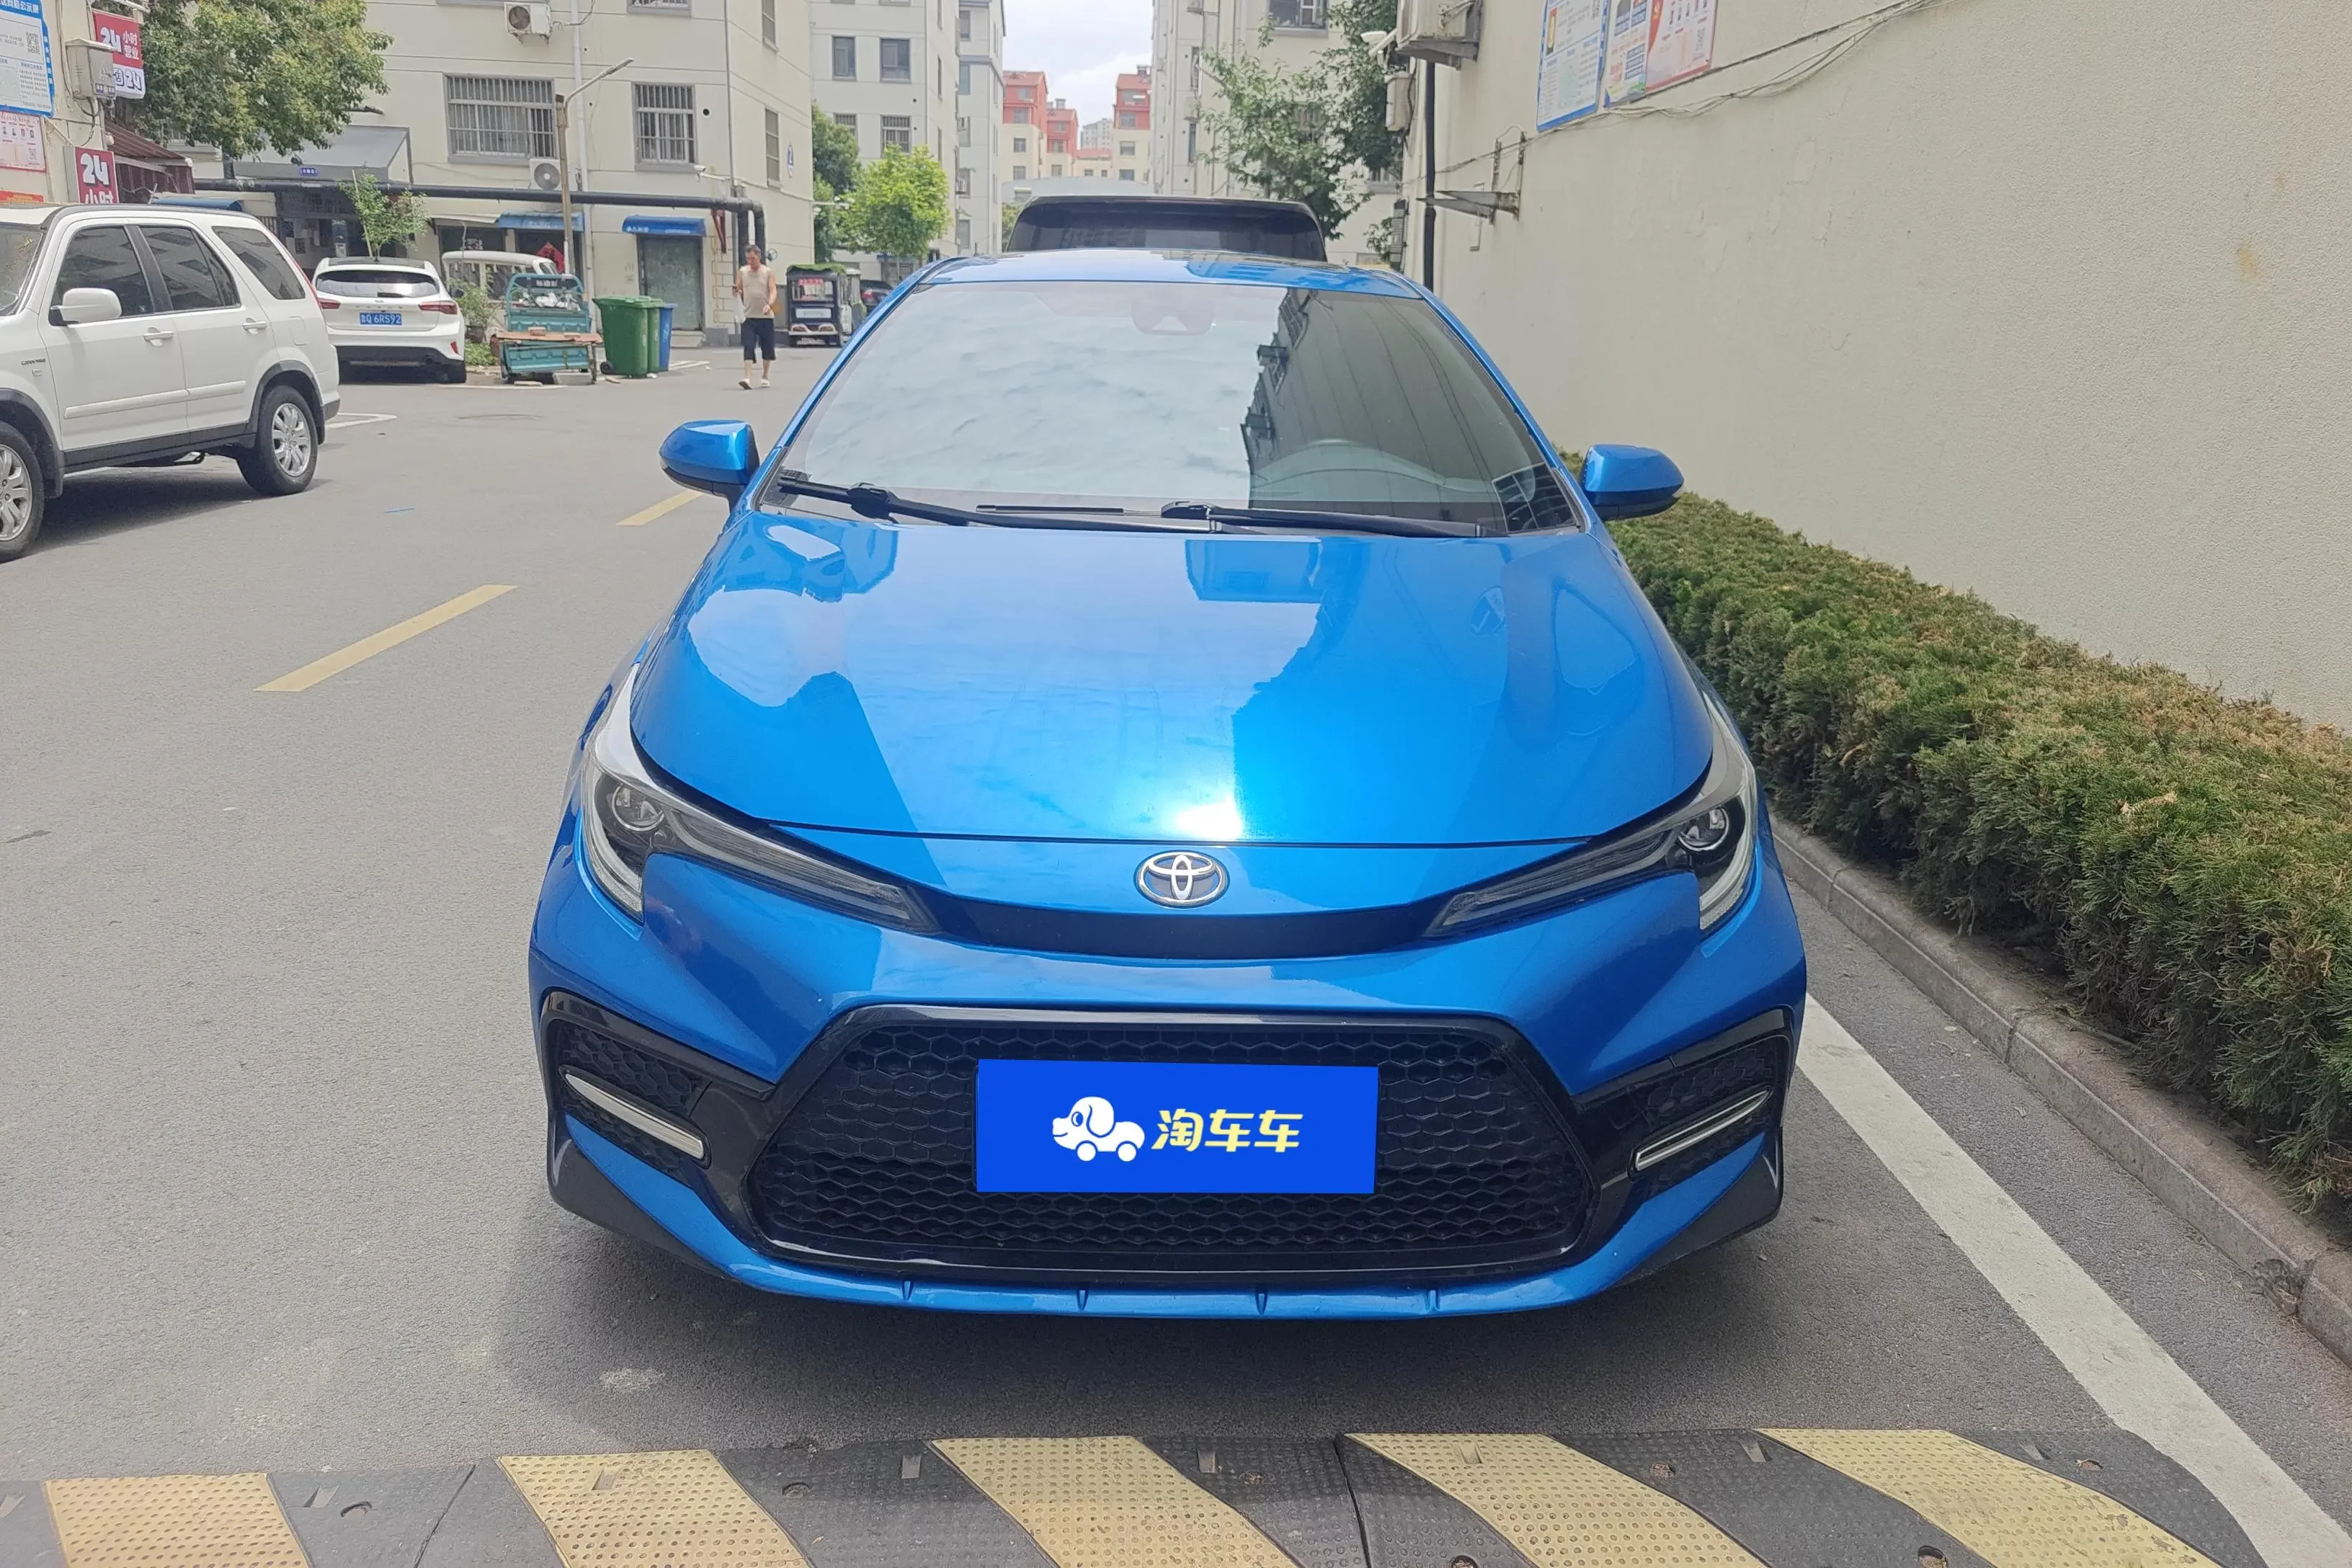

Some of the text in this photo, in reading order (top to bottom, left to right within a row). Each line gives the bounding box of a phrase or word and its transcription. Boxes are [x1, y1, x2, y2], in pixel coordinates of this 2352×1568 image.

[100, 27, 122, 53] 24
[122, 31, 138, 45] 小时
[124, 45, 140, 60] 营业
[125, 69, 142, 91] 24
[81, 153, 110, 185] 24
